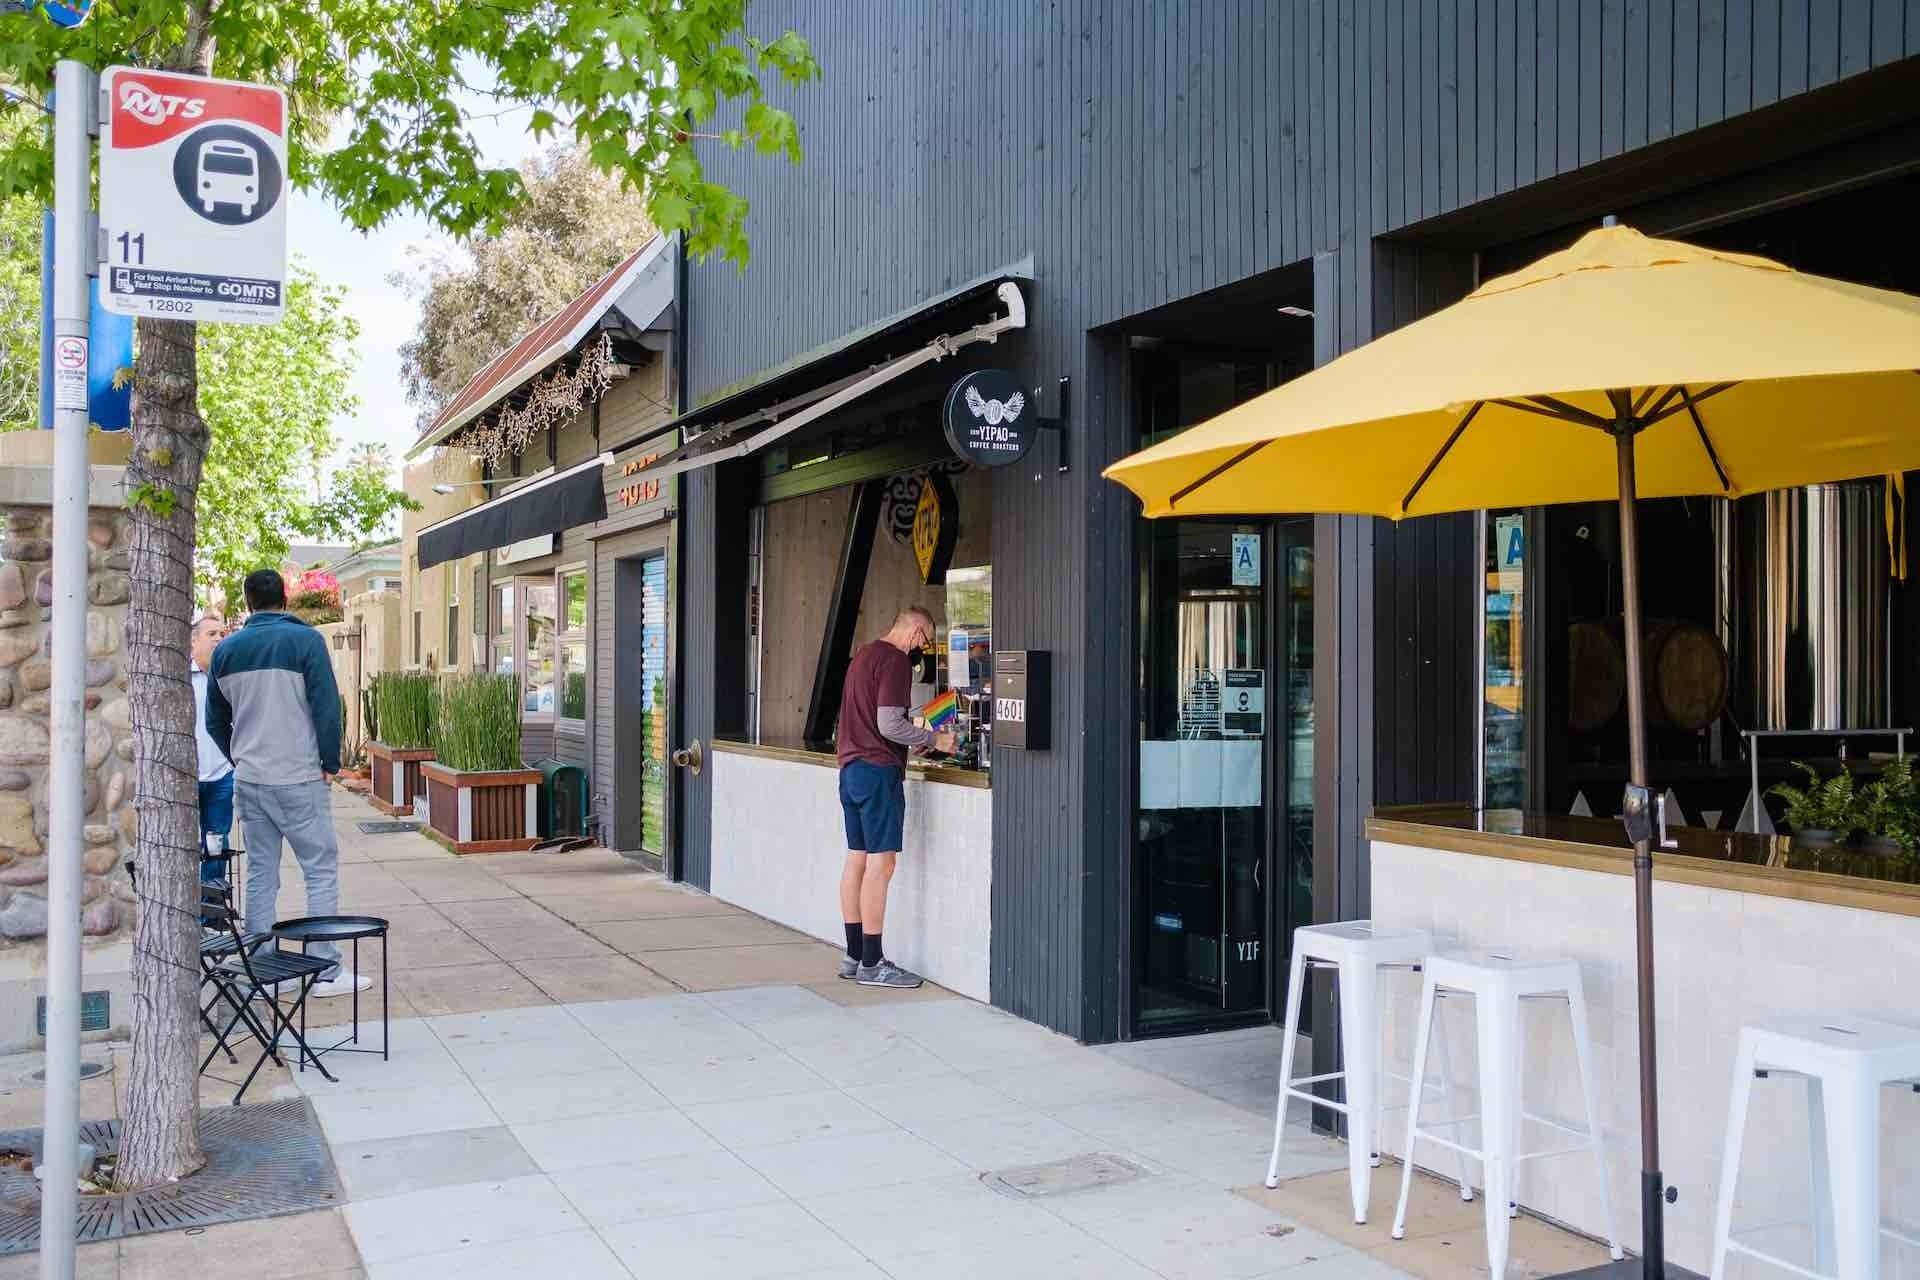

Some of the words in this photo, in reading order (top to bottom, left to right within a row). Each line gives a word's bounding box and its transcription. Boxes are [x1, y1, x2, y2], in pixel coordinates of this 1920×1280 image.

[120, 91, 207, 119] MTS
[117, 231, 145, 265] 11
[133, 272, 147, 281] For
[133, 280, 152, 289] Text
[152, 281, 172, 292] Stop
[173, 282, 204, 293] Number
[204, 286, 214, 295] to
[148, 298, 193, 313] 12802
[979, 425, 1009, 442] YIPAO
[969, 441, 990, 449] COFFEE
[992, 442, 1020, 452] ROASTERS
[1506, 527, 1526, 565] A
[1239, 545, 1253, 569] A
[997, 699, 1023, 721] 4601
